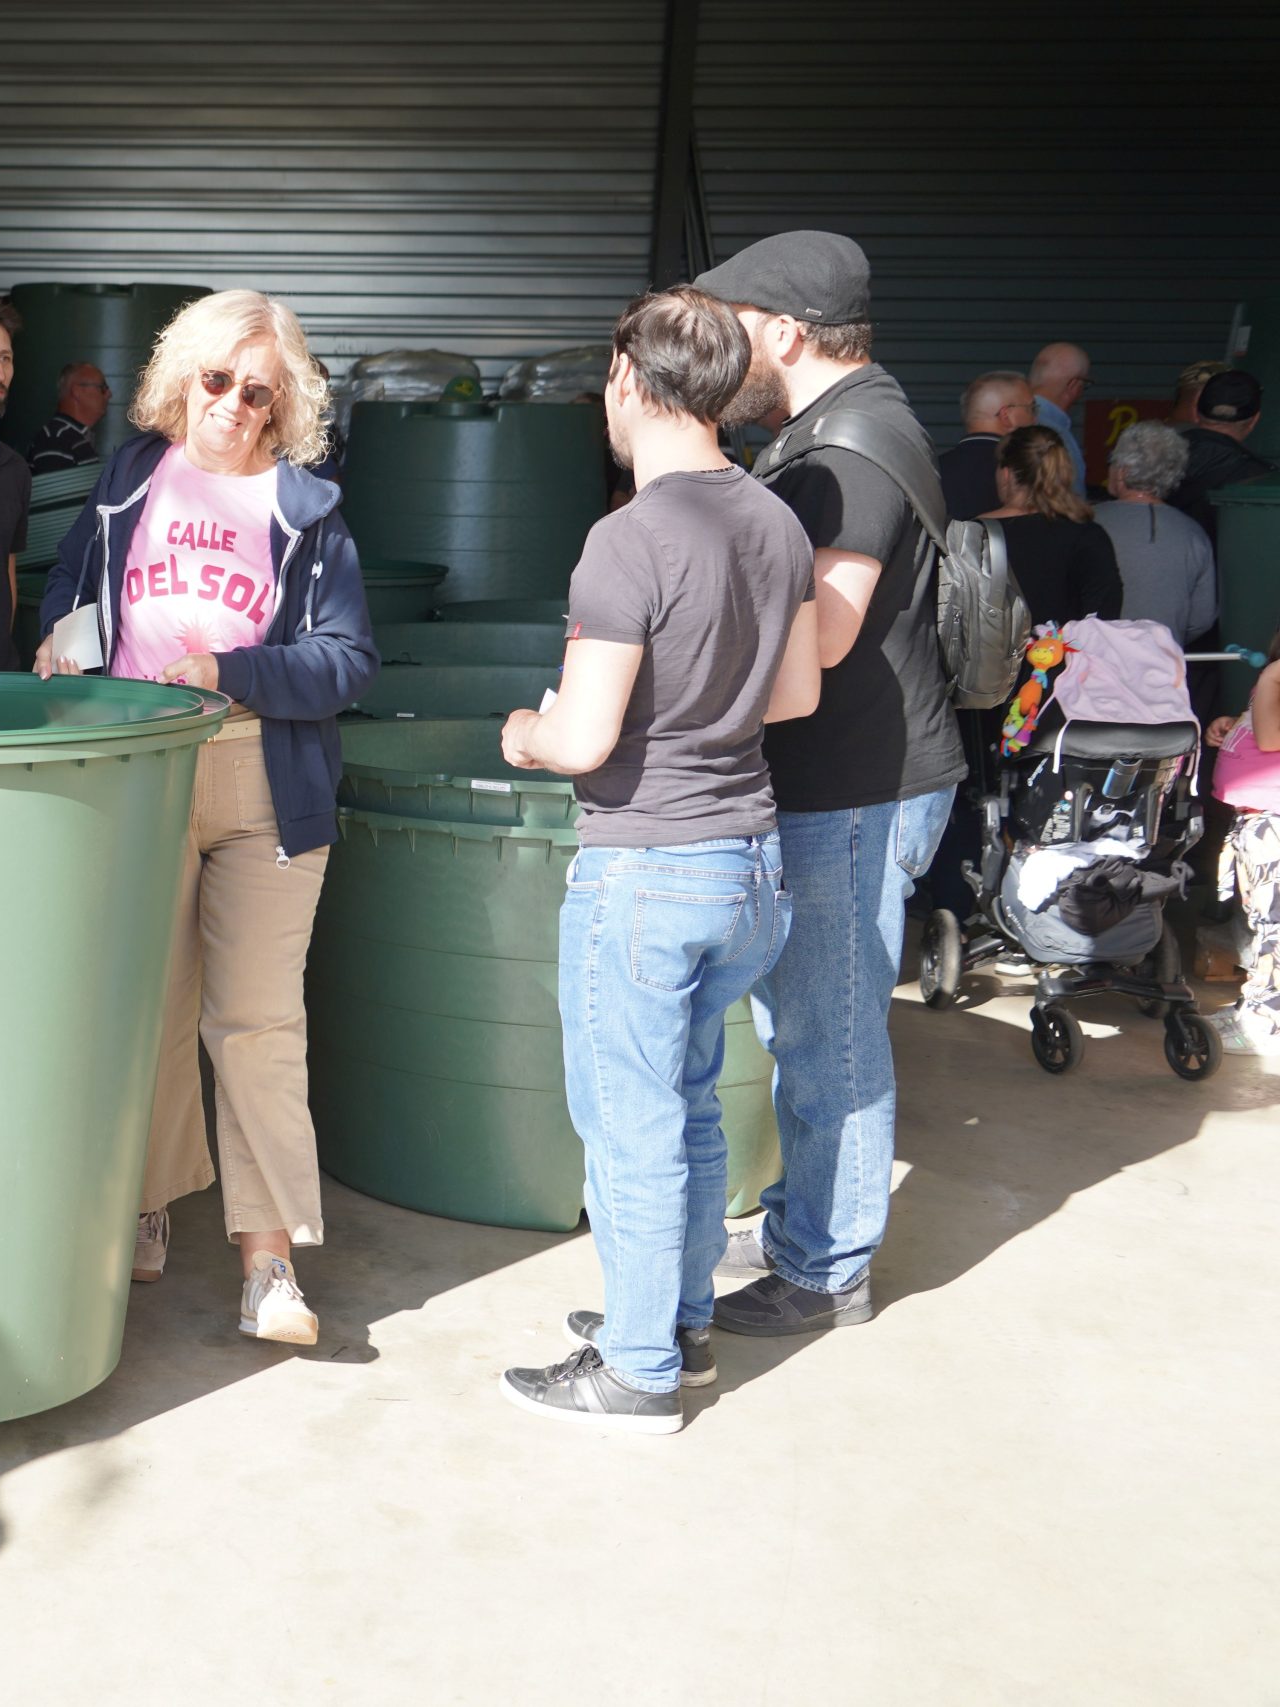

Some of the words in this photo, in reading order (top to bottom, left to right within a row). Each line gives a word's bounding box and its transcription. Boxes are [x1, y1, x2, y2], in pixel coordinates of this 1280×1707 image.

[167, 520, 237, 552] CALLE
[126, 553, 189, 606] DEL
[197, 564, 270, 625] SOL
